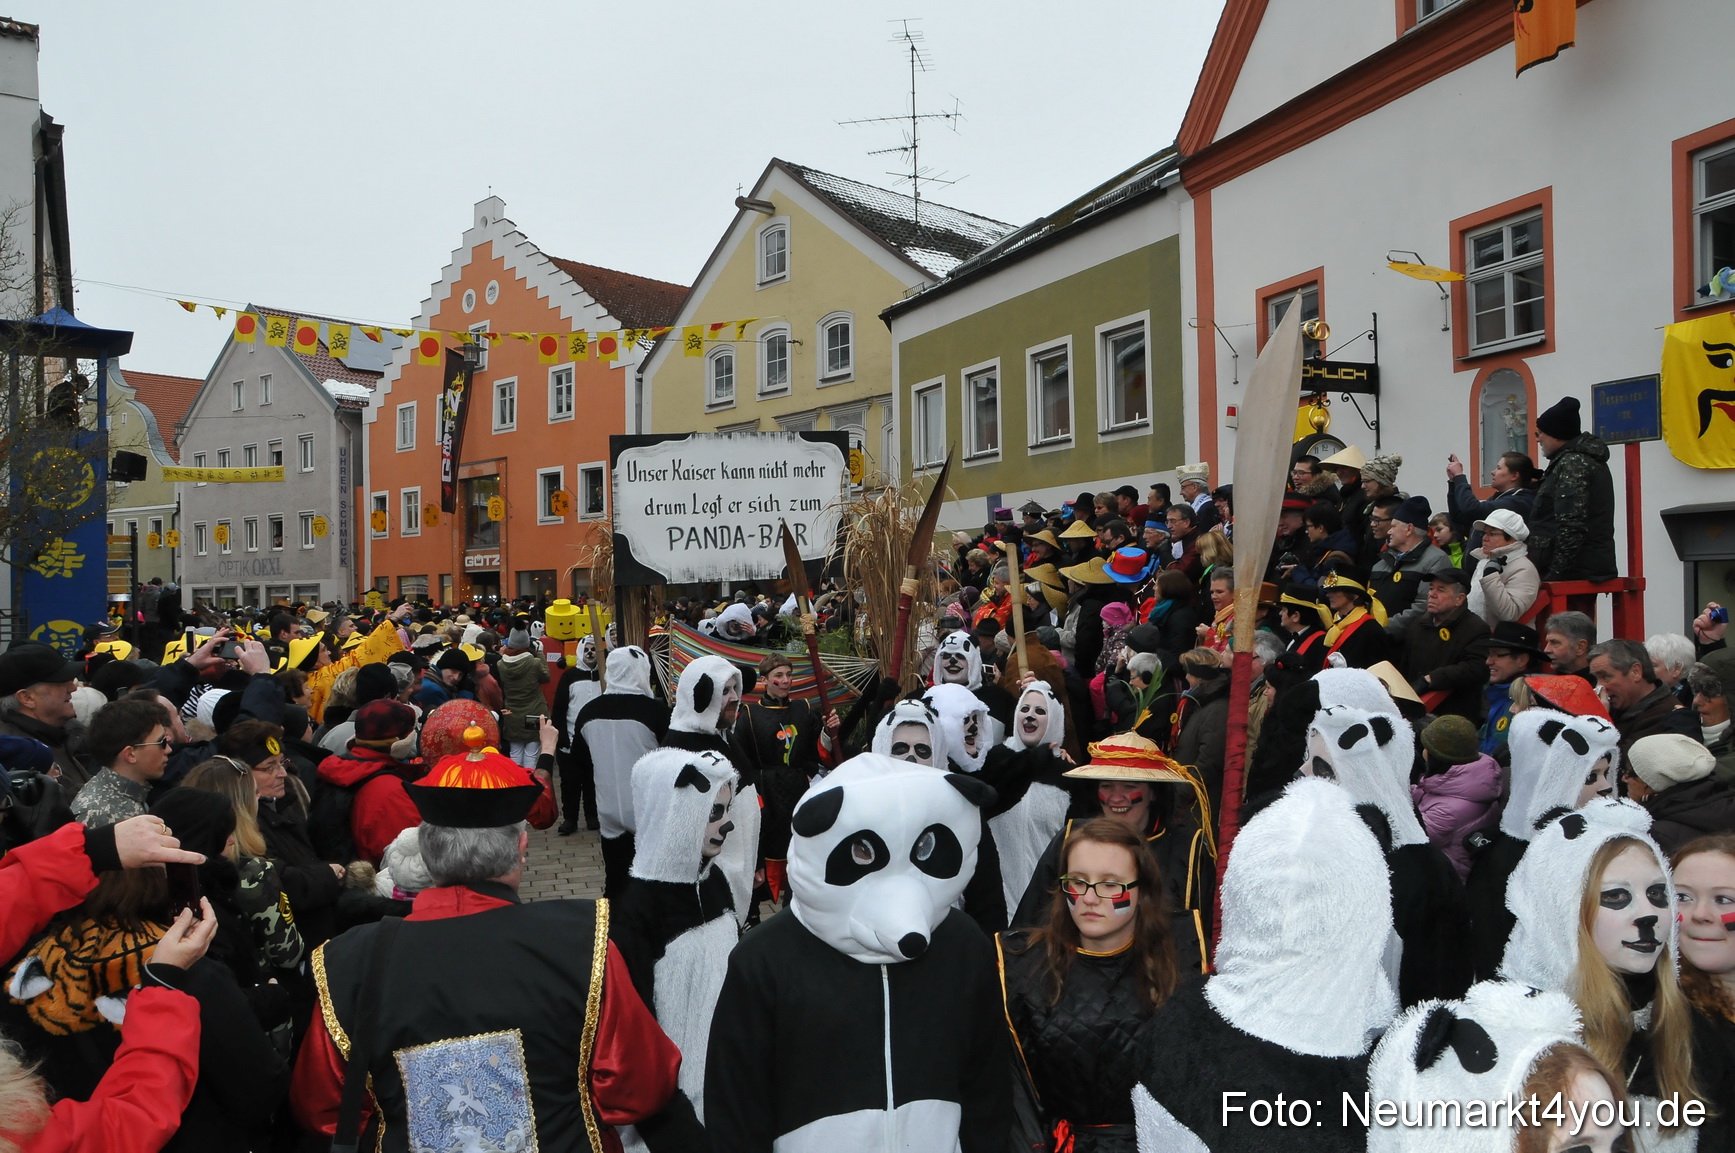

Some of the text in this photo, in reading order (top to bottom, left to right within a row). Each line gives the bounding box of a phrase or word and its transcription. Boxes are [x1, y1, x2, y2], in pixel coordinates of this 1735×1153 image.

[1301, 365, 1367, 380] ÖHLICH
[627, 458, 826, 483] Unser Kaiser kann nicht mehr
[644, 492, 822, 519] drum Legt er sich zum
[340, 500, 348, 566] SCHMUCK
[219, 557, 284, 578] OPTIK OEXL
[464, 554, 500, 567] GÖTZ
